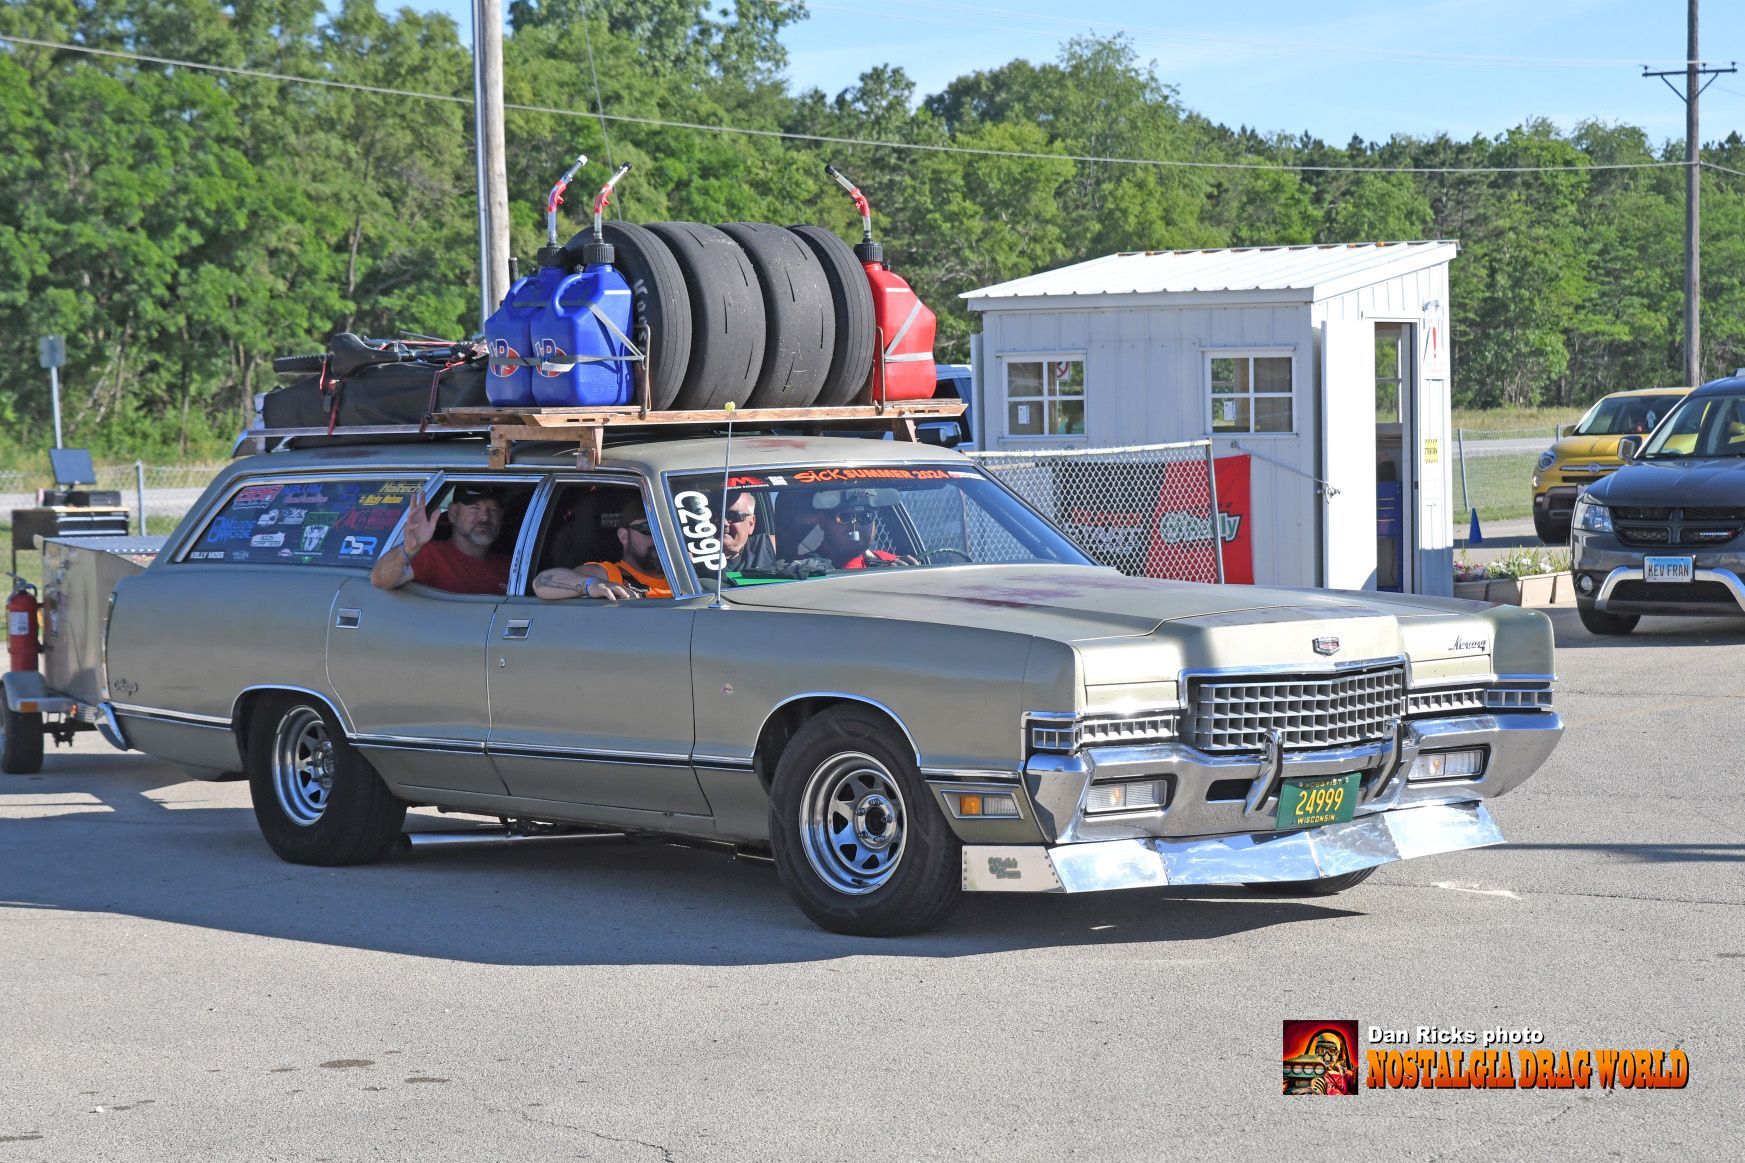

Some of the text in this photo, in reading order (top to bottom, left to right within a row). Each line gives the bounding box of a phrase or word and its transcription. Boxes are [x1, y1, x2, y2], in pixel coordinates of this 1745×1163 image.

[842, 469, 914, 479] SUMMER
[912, 469, 950, 480] 2024
[380, 482, 423, 493] Haltech
[674, 491, 728, 571] C299P
[340, 535, 377, 555] DSR
[208, 551, 225, 559] MOSS
[1648, 564, 1689, 577] KEV FRAN
[1295, 787, 1343, 815] 24999
[1297, 814, 1336, 825] WISCONSIN
